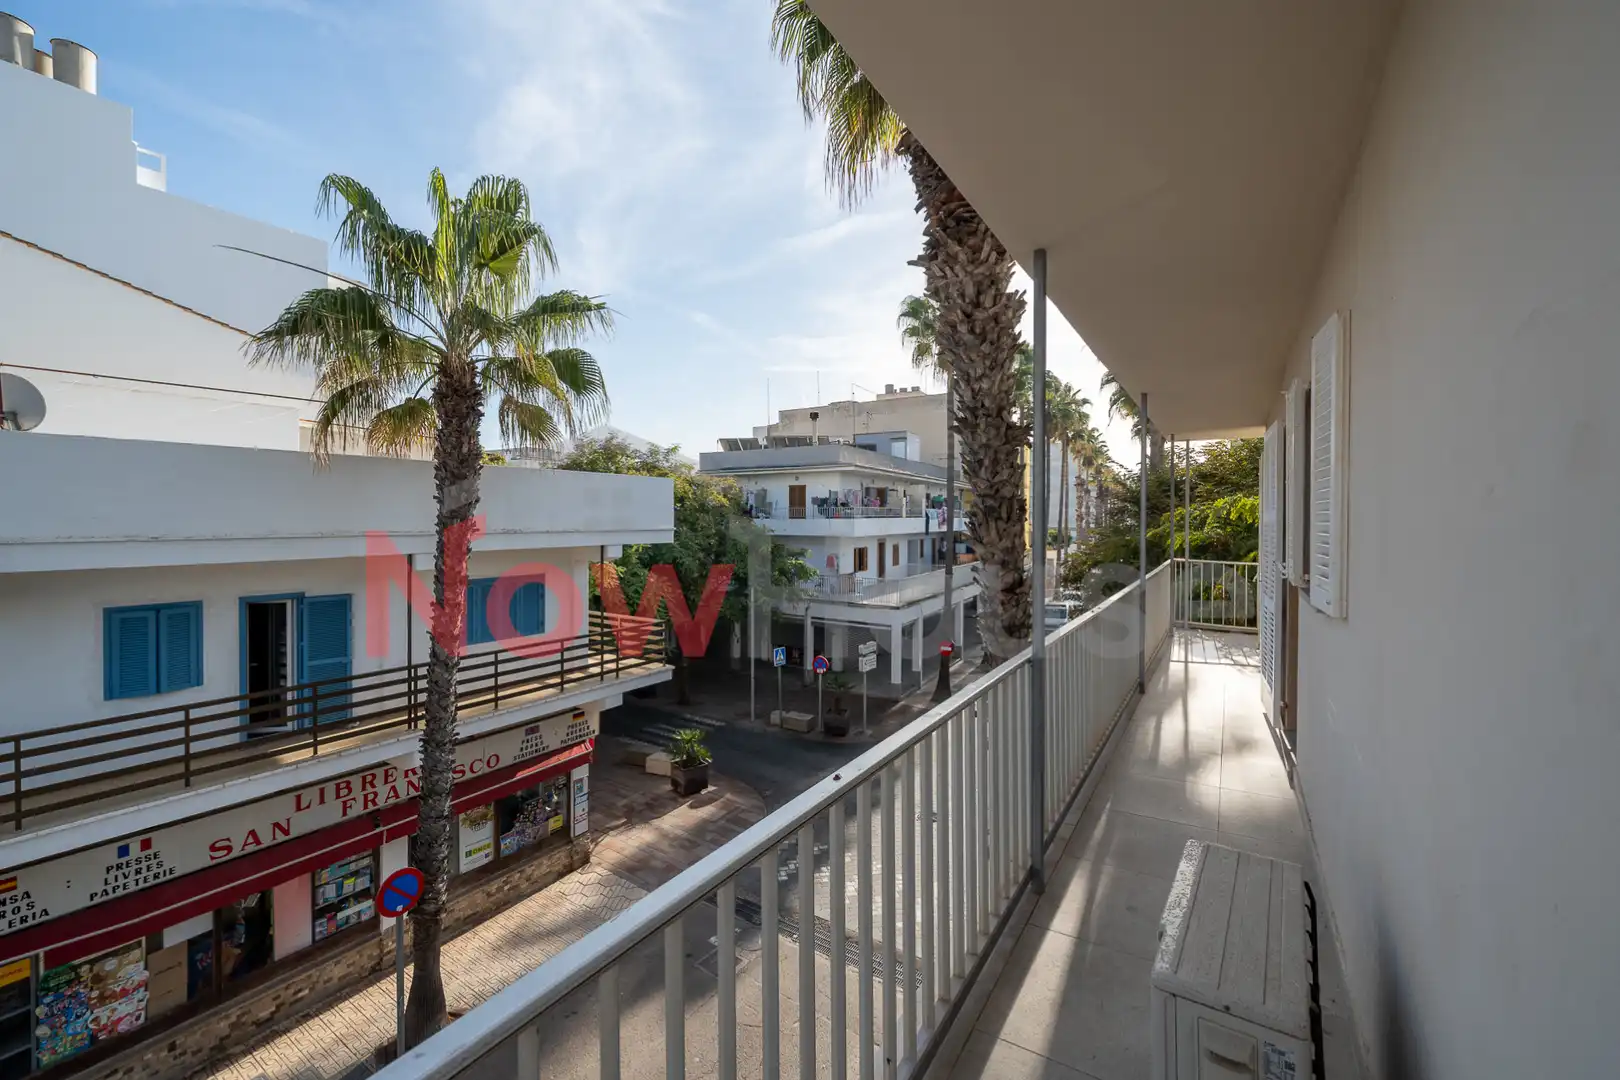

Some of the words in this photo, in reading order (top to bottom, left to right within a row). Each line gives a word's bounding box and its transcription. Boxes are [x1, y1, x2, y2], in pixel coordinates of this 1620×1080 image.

[520, 740, 544, 753] BOOKS
[521, 734, 543, 746] PRESS
[513, 745, 550, 762] STATIONERY
[208, 817, 292, 862] SAN
[341, 753, 500, 818] FRANSCO
[103, 860, 164, 887] LIVRES
[105, 850, 162, 875] PRESSE
[89, 866, 177, 902] PAPETERIE
